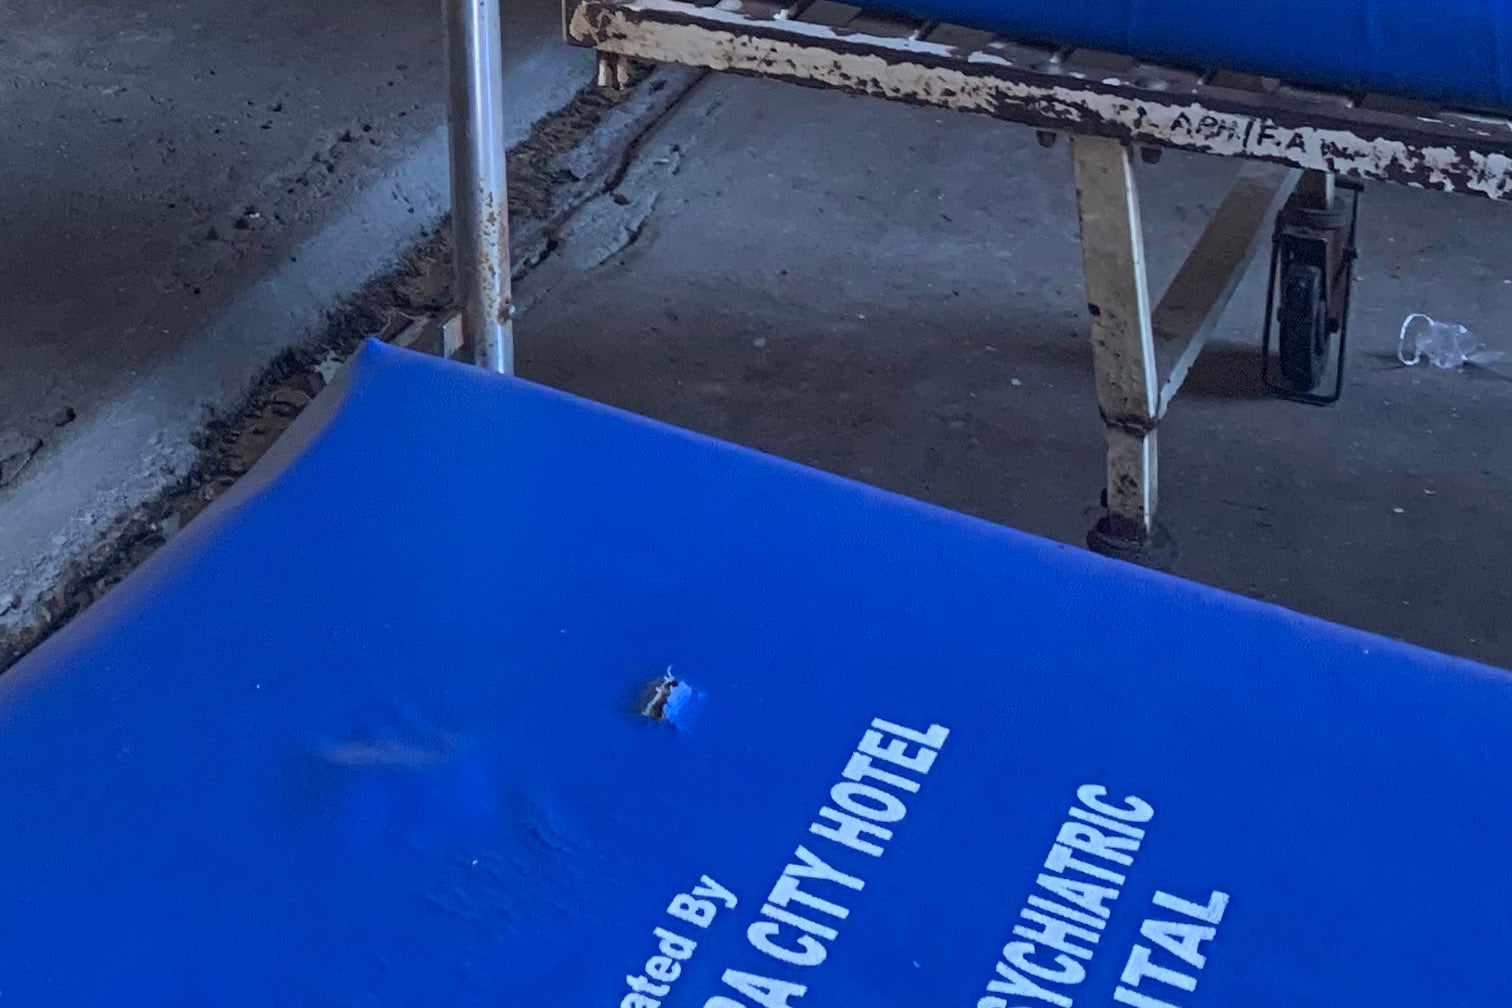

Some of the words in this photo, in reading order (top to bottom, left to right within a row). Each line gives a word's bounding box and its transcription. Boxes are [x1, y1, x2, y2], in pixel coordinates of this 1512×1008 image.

[666, 874, 738, 929] By
[746, 844, 866, 967] CITY
[808, 716, 951, 859] HOTEL
[976, 783, 1156, 1008] YCHIATRIC
